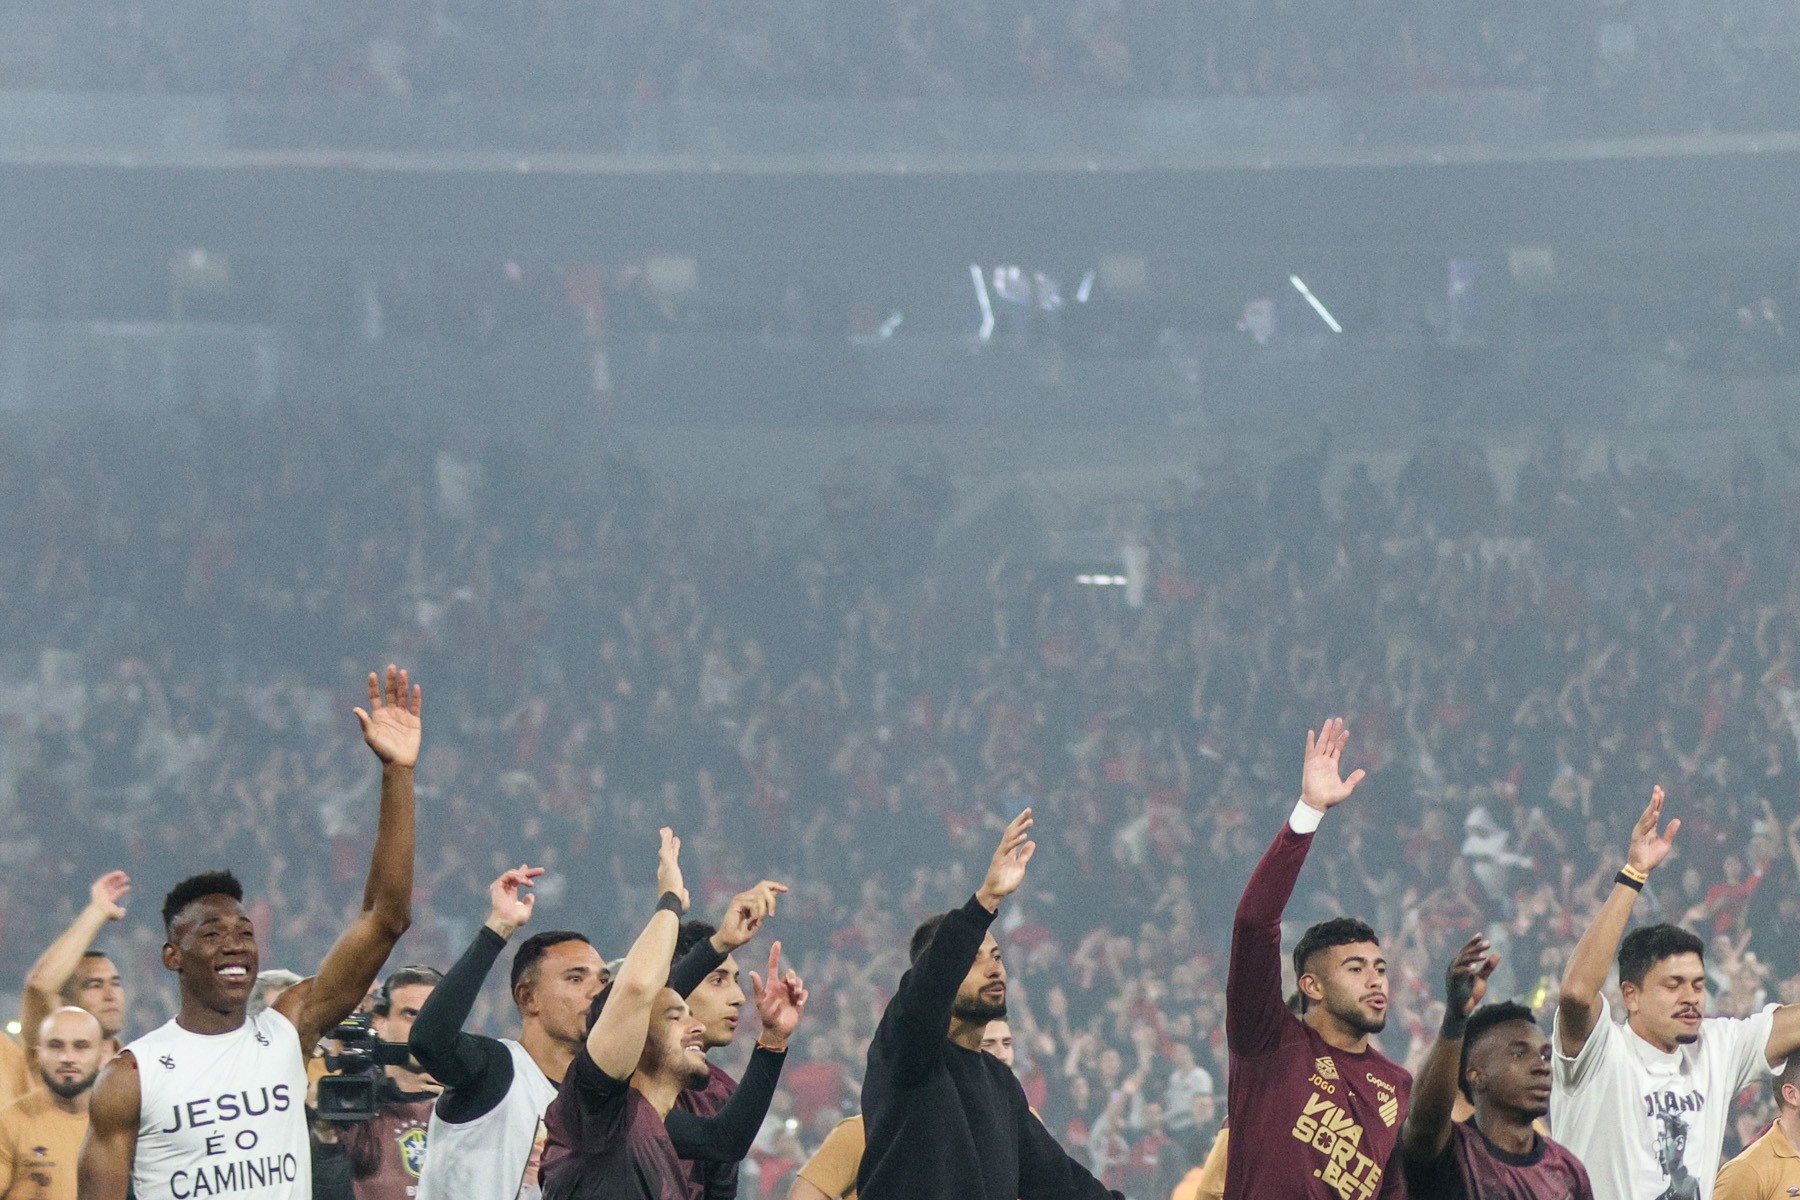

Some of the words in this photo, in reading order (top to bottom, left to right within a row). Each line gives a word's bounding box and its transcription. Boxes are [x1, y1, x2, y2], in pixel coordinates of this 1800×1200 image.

[1308, 1073, 1336, 1095] JOGO
[162, 1084, 290, 1134] JESUS
[1302, 1091, 1364, 1148] VIVA
[205, 1130, 226, 1156] É
[235, 1129, 258, 1150] O
[1291, 1114, 1382, 1191] SORTE
[170, 1152, 297, 1200] CAMINHO
